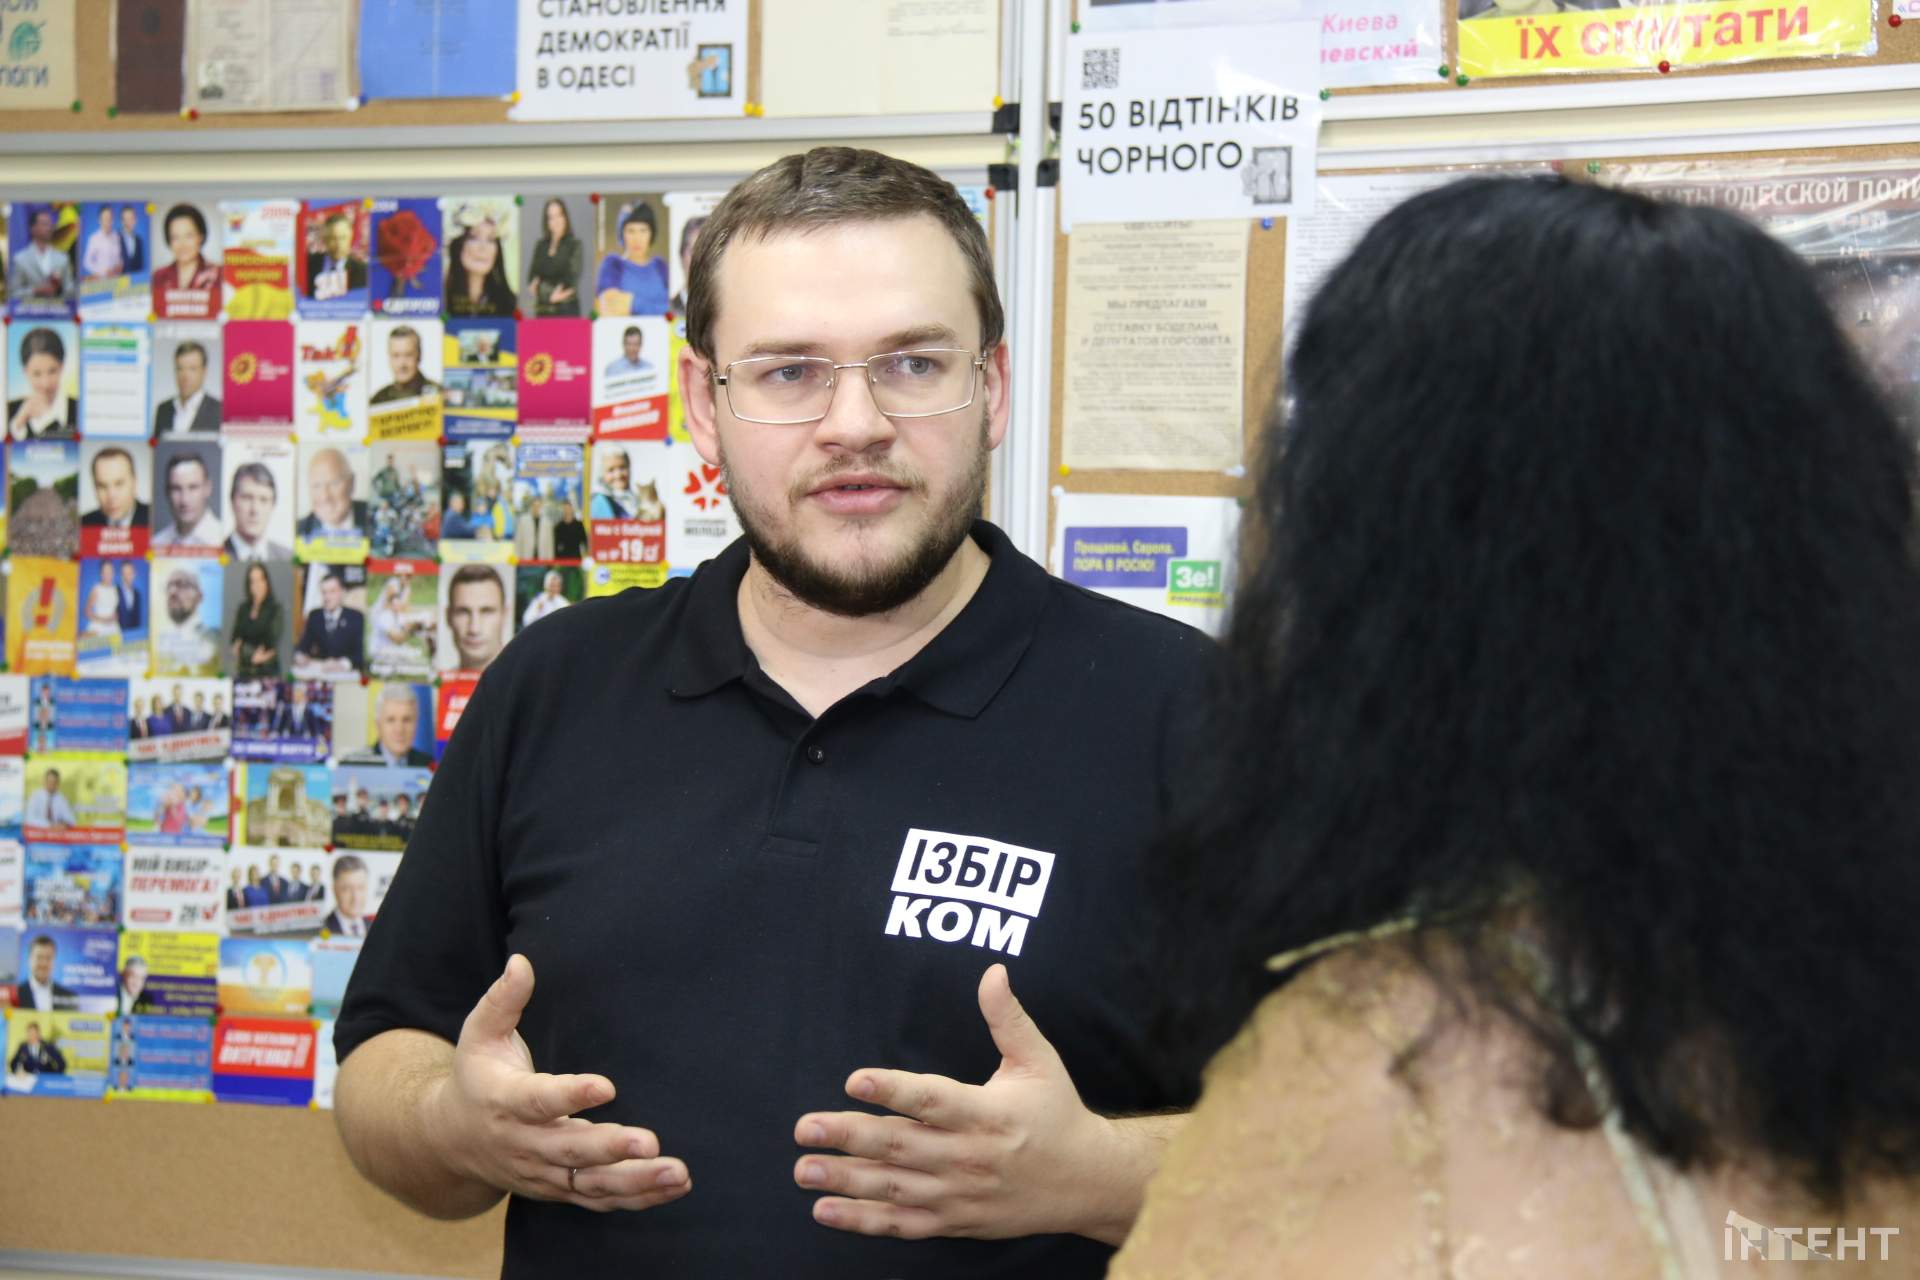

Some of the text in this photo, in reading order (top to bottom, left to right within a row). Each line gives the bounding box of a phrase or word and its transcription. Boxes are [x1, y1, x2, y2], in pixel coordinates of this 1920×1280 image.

[537, 0, 726, 18] СТАНОВЛЕННЯ
[1321, 13, 1398, 33] Киева
[536, 21, 691, 57] ДЕМОКРАТІЇ
[1515, 5, 1809, 59] їх спитати
[537, 66, 635, 91] В ОДЕСІ
[1079, 95, 1299, 132] 50 ВІДТІНКІВ
[1077, 141, 1243, 175] ЧОРНОГО
[1724, 177, 1849, 211] ОДЕССКОЙ
[1175, 565, 1215, 589] Зе!
[908, 838, 1042, 898] ІЗБІР
[884, 895, 1030, 957] КОМ
